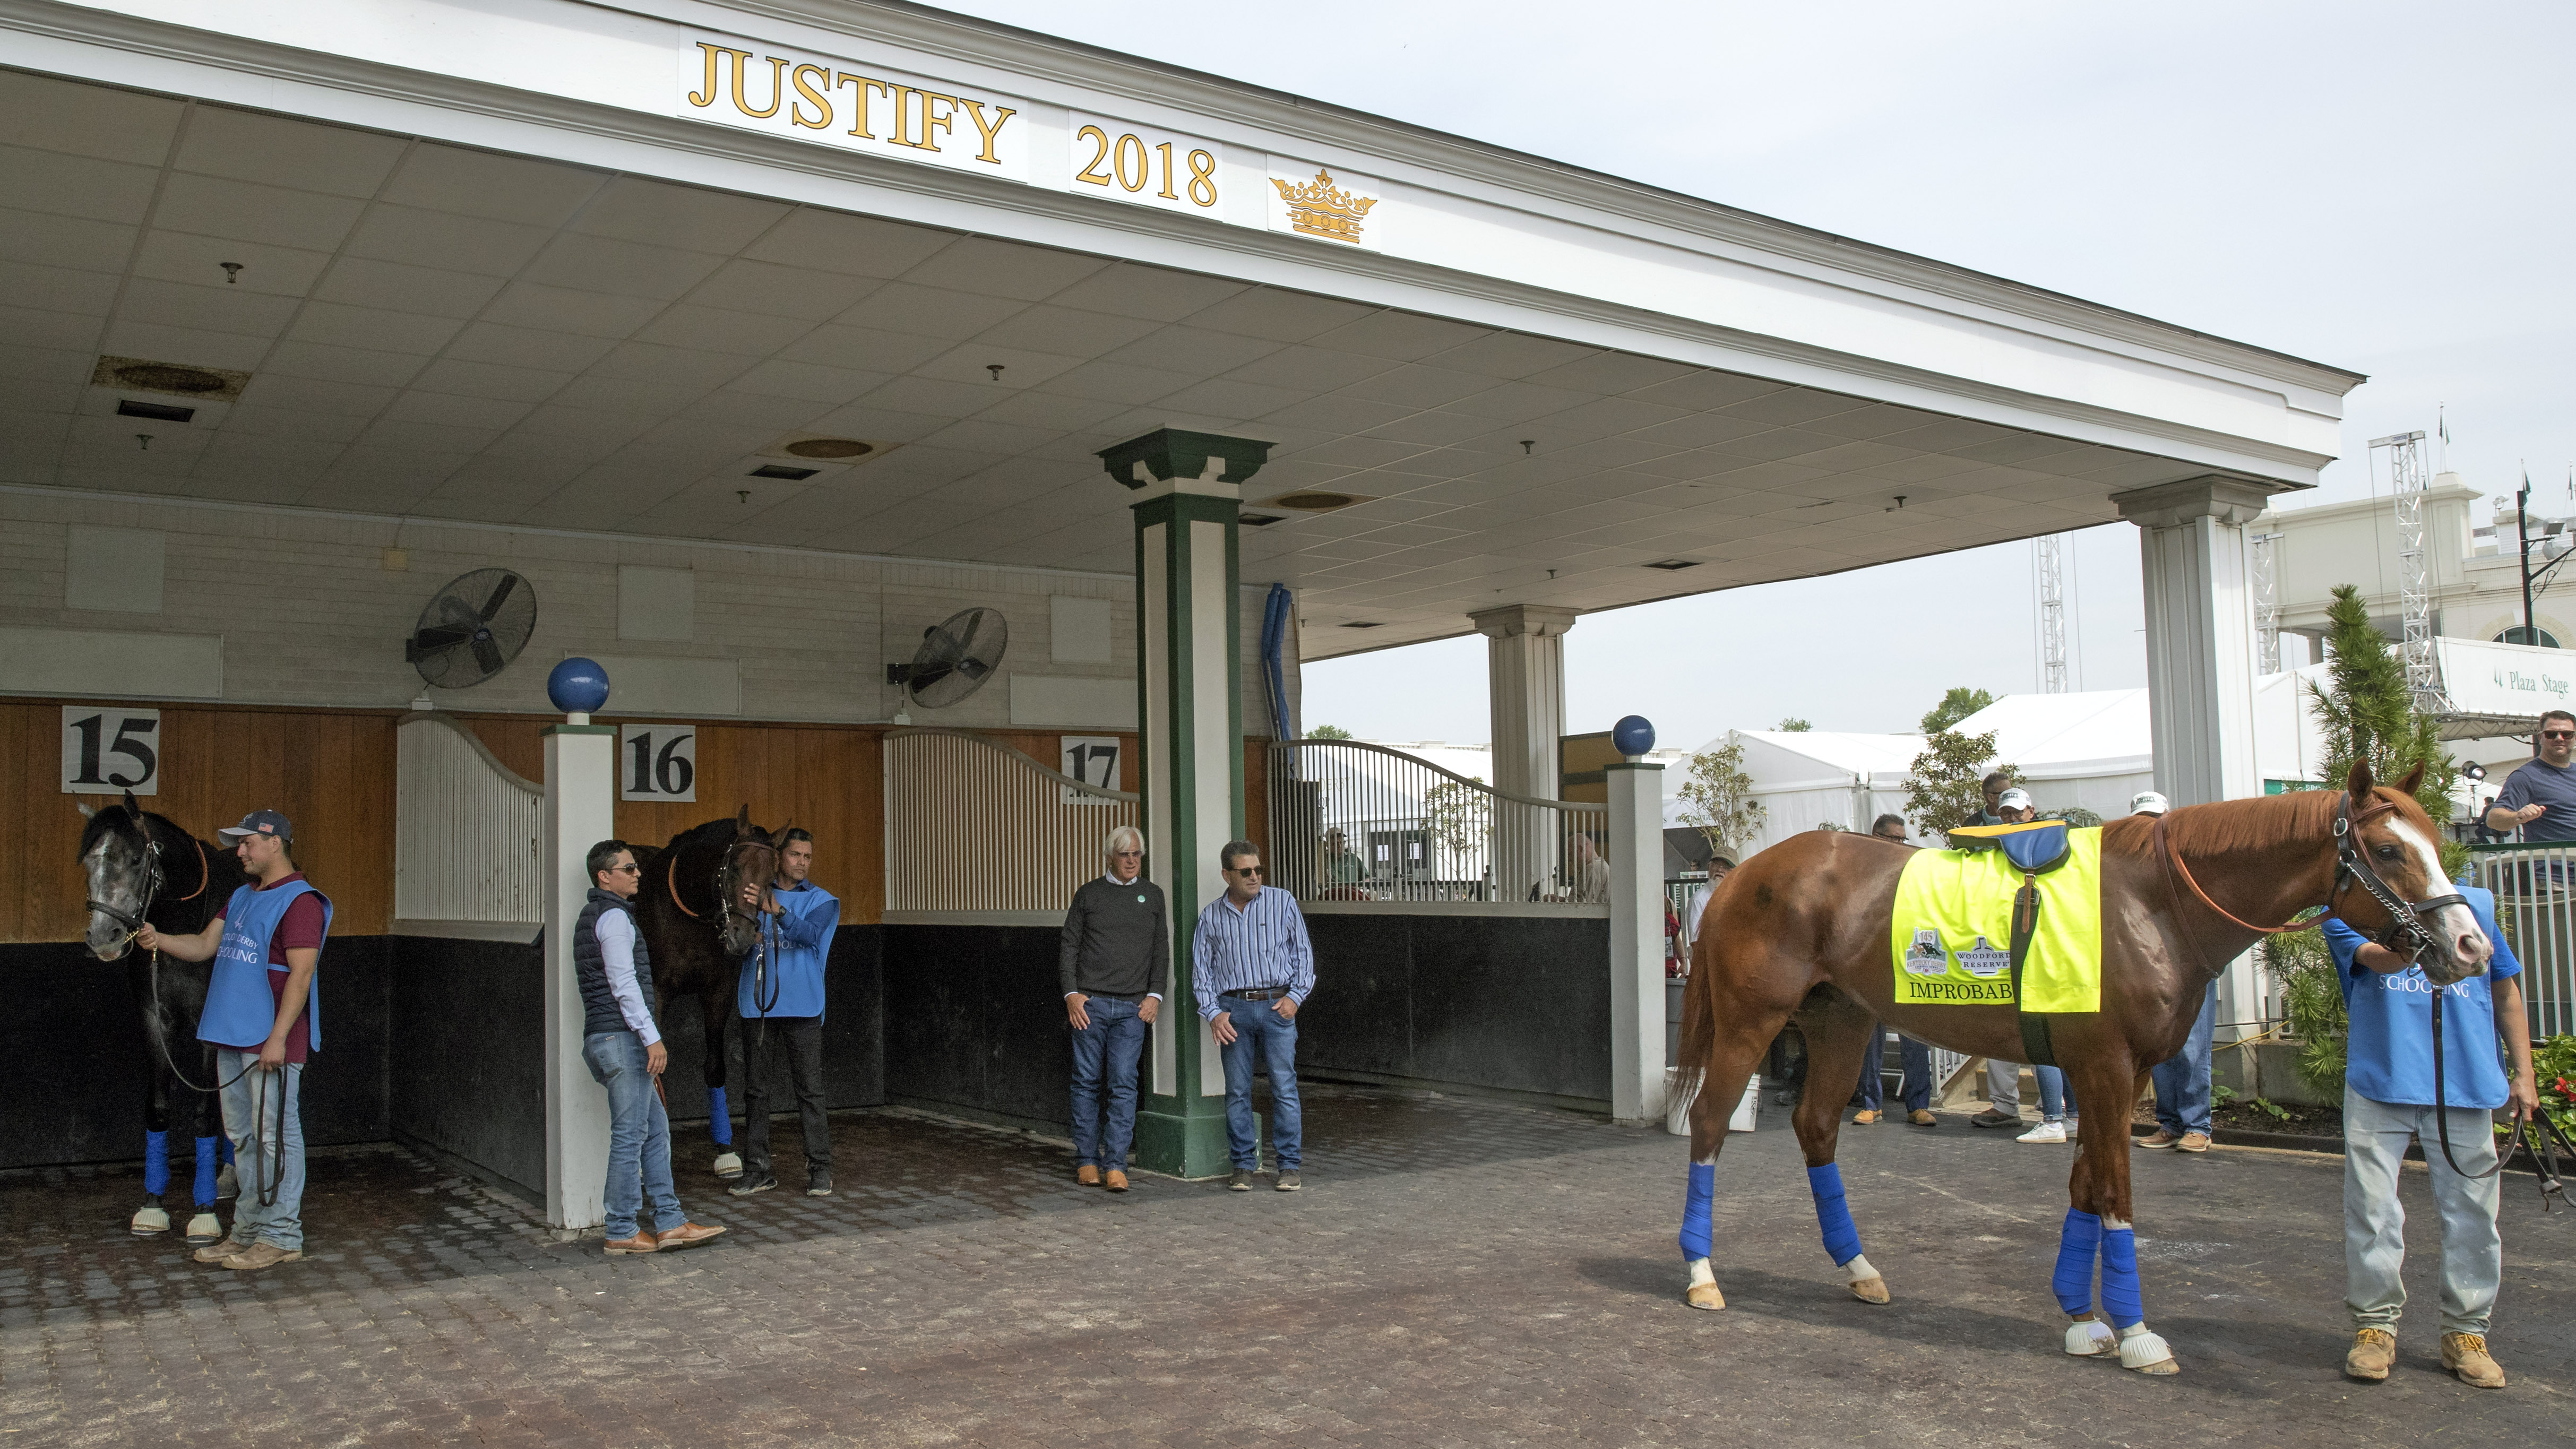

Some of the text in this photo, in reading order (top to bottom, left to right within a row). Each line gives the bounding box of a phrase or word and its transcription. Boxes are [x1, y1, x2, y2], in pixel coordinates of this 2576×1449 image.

[688, 41, 1217, 207] JUSTIFY 2018
[2509, 671, 2569, 700] Plaza Stage
[69, 713, 158, 787] 15
[626, 731, 693, 795] 16
[1066, 743, 1118, 798] 17
[1919, 931, 1932, 941] 145
[217, 946, 259, 964] CHOOLING
[1909, 982, 2013, 1000] IMPROBAB
[2379, 975, 2469, 997] SCHOOING
